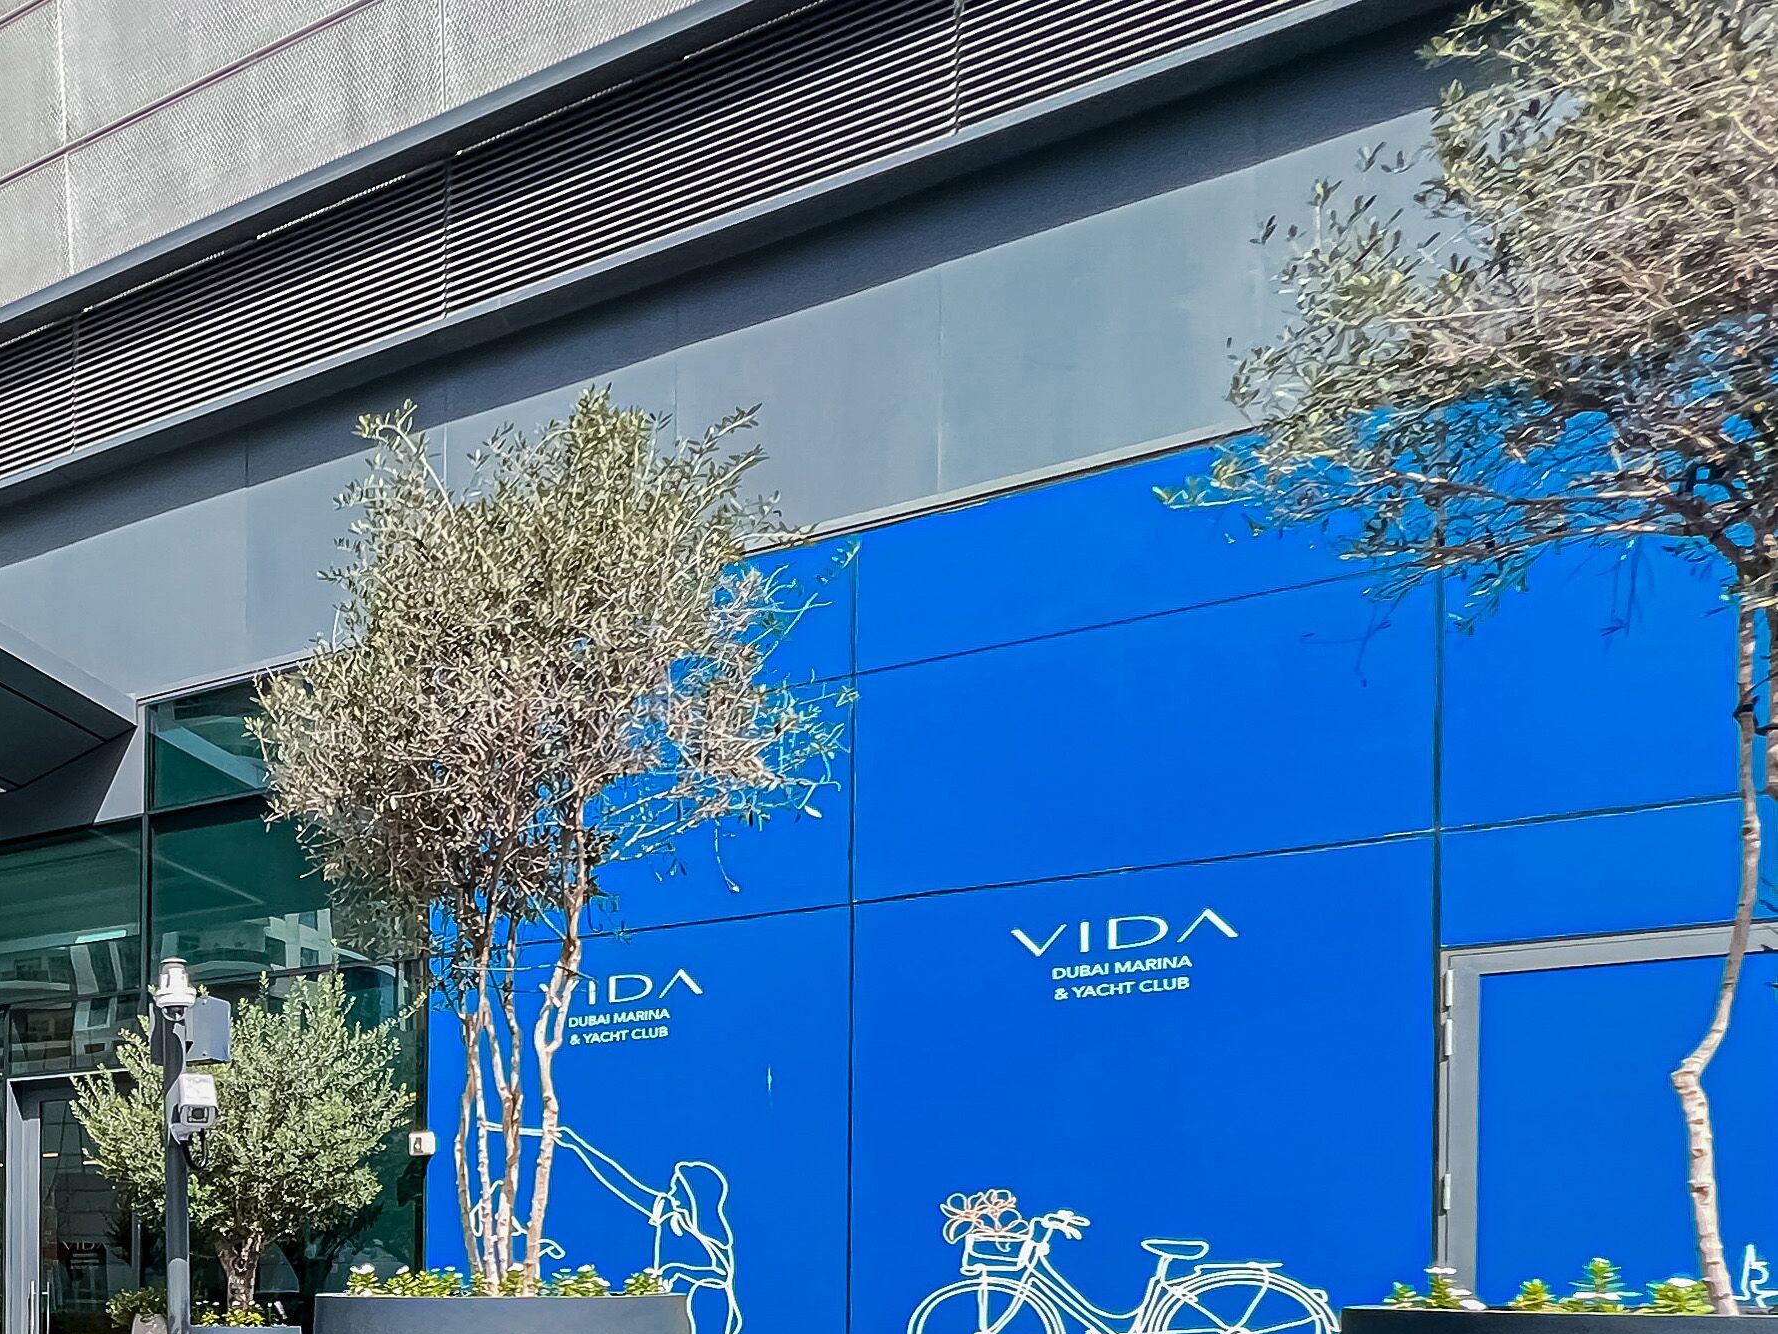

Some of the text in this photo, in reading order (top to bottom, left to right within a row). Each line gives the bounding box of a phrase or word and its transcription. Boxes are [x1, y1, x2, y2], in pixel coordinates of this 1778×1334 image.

[1011, 908, 1239, 957] VIDA
[1051, 955, 1193, 980] DUBAI MARINA
[1053, 976, 1190, 1001] & YACHT CLUB
[568, 1008, 671, 1028] DUBAI MARINA
[569, 1025, 669, 1046] & YACHT CLUB
